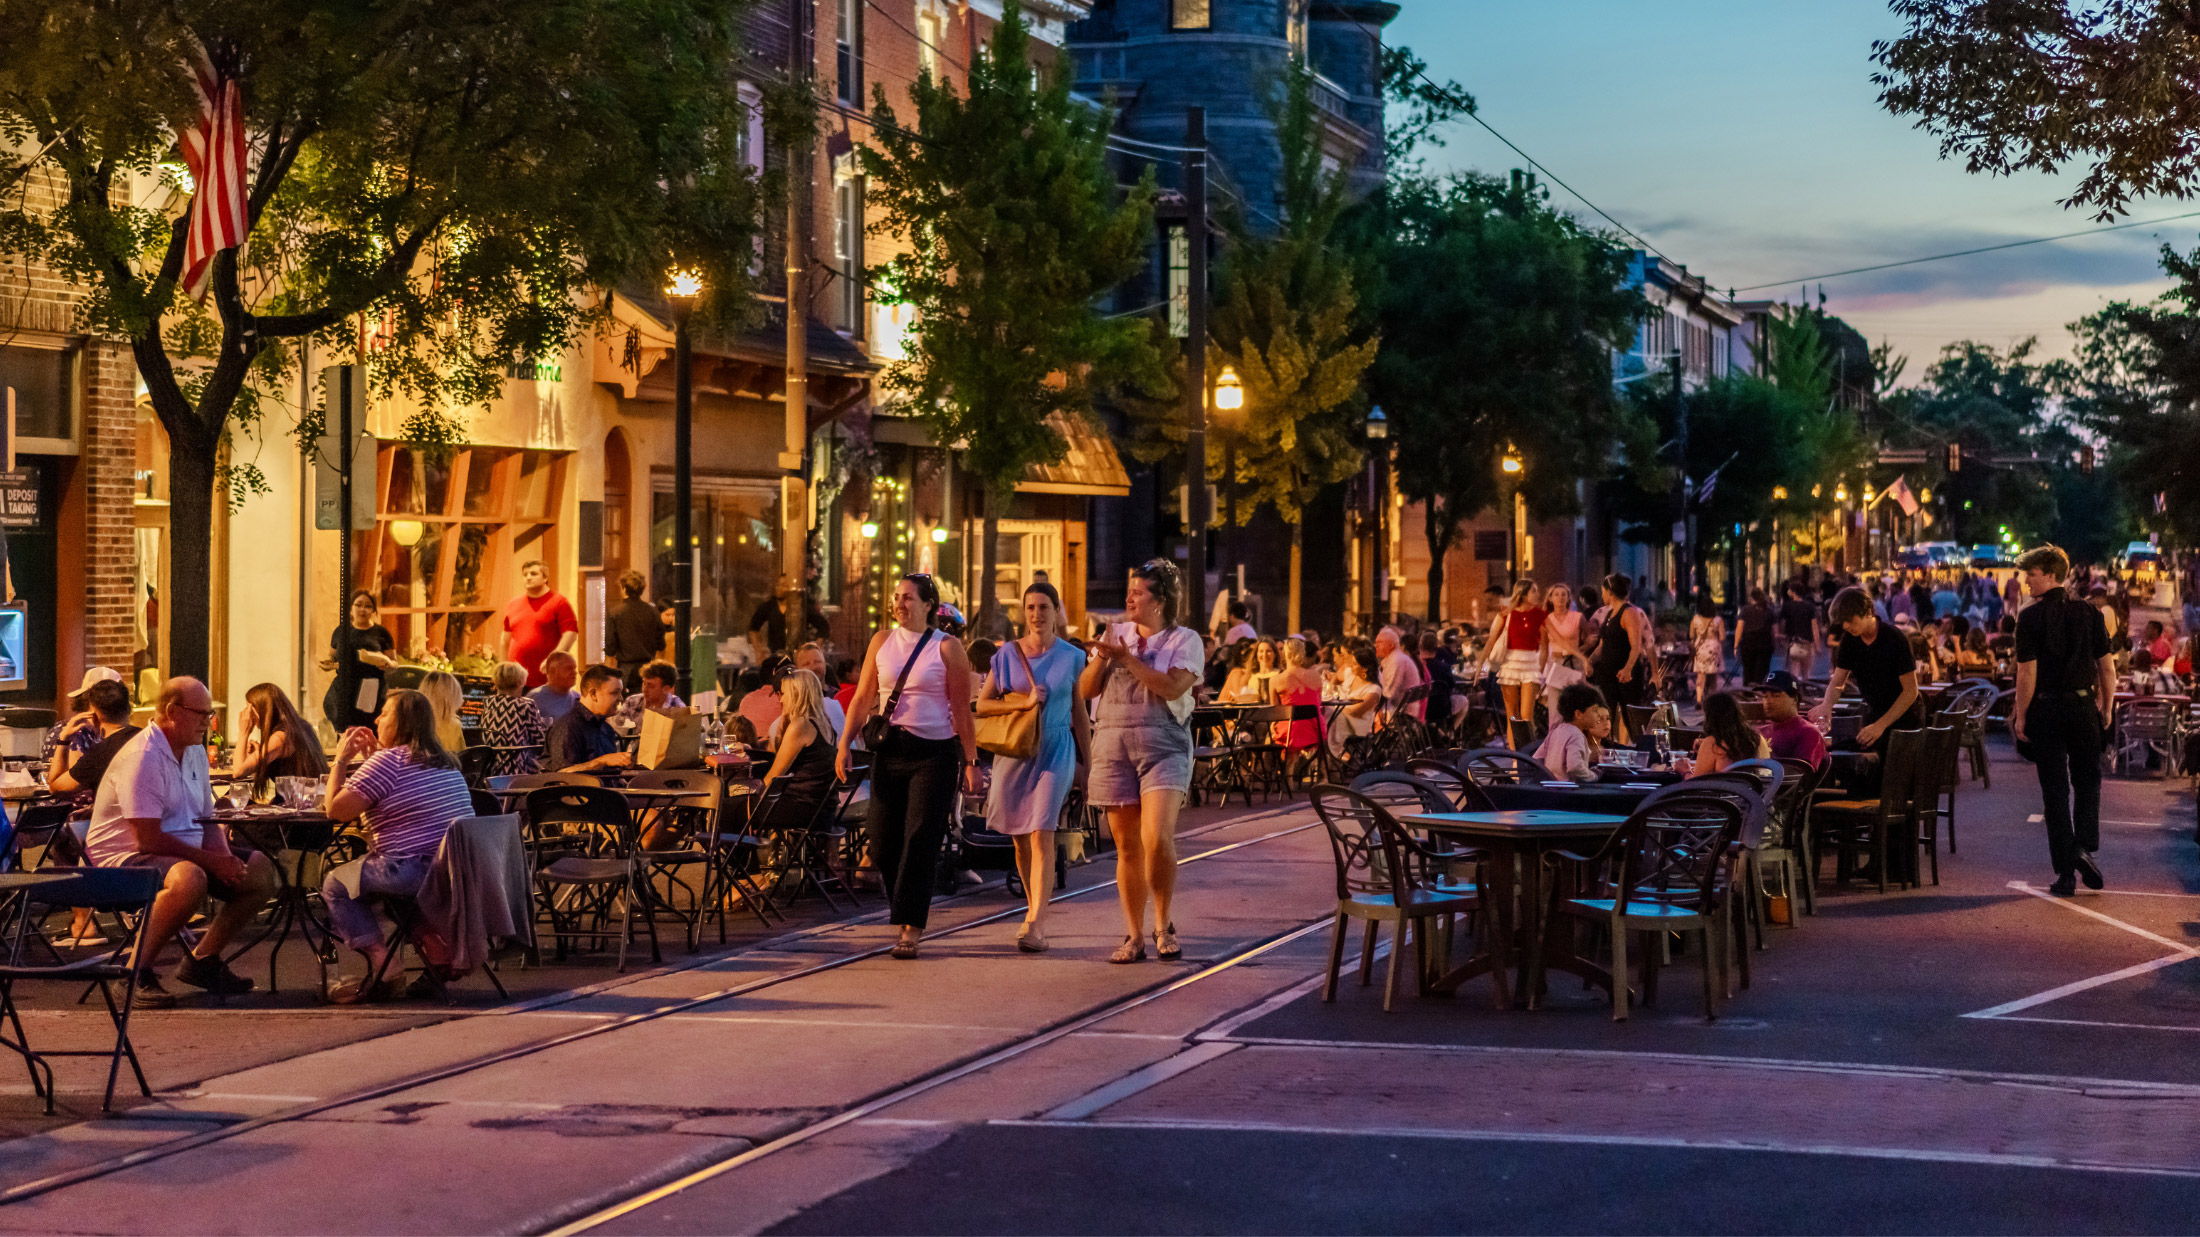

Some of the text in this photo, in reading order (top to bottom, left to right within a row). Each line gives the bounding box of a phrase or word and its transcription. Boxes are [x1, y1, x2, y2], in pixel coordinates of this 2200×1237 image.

[7, 489, 38, 501] DEPOSIT
[8, 502, 37, 514] TAKING
[321, 500, 335, 508] PP
[1766, 672, 1775, 682] P
